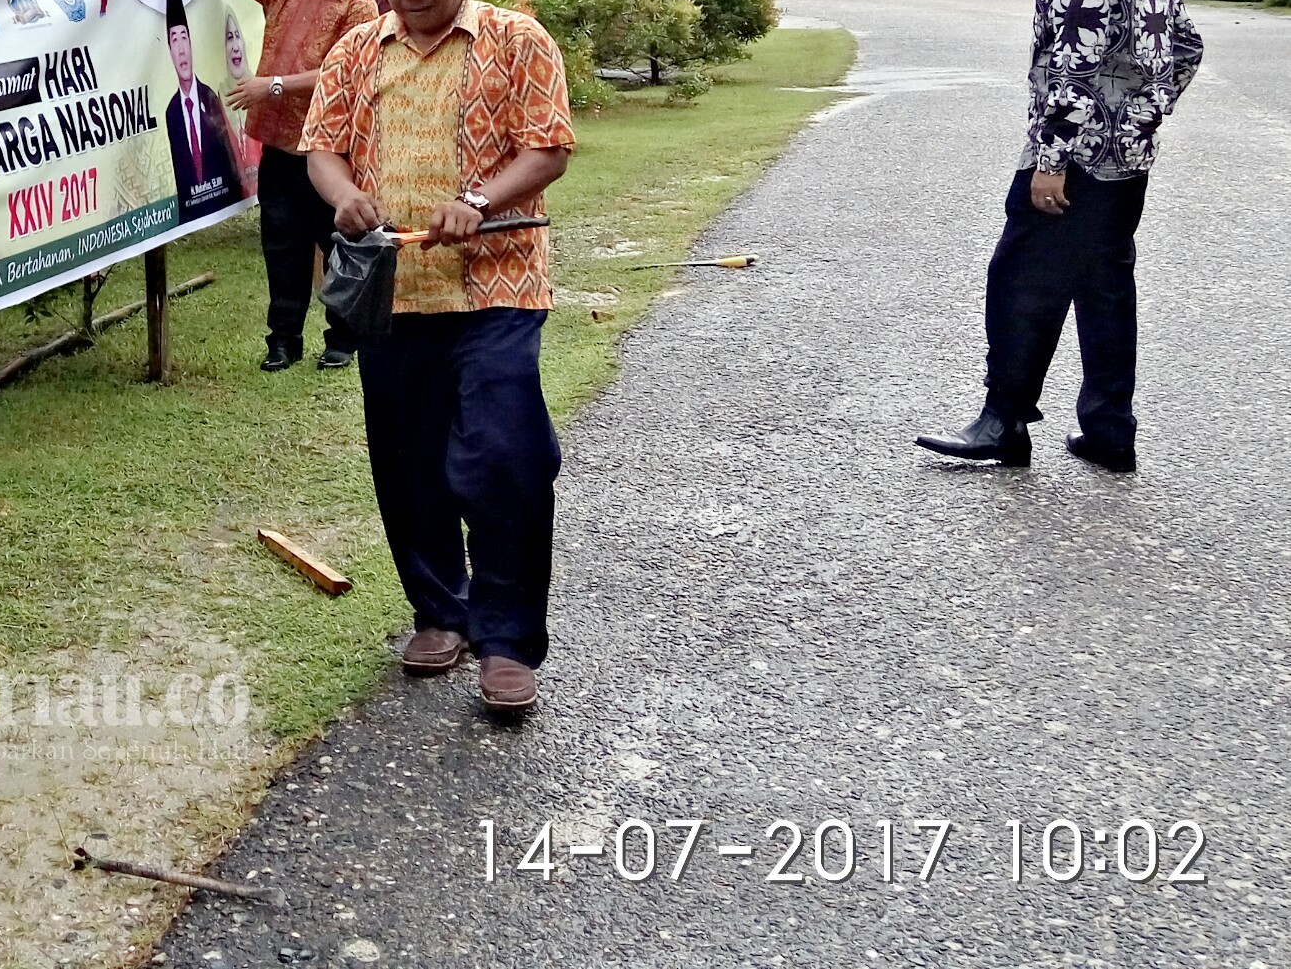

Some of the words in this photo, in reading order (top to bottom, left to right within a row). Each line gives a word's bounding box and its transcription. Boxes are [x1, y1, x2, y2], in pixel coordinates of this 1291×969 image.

[44, 45, 99, 100] HARI
[54, 85, 158, 156] NASIONAL
[7, 178, 54, 240] XXIV
[59, 167, 98, 223] 2017
[7, 248, 75, 283] Bertahanan,
[77, 219, 132, 257] INDONESIA
